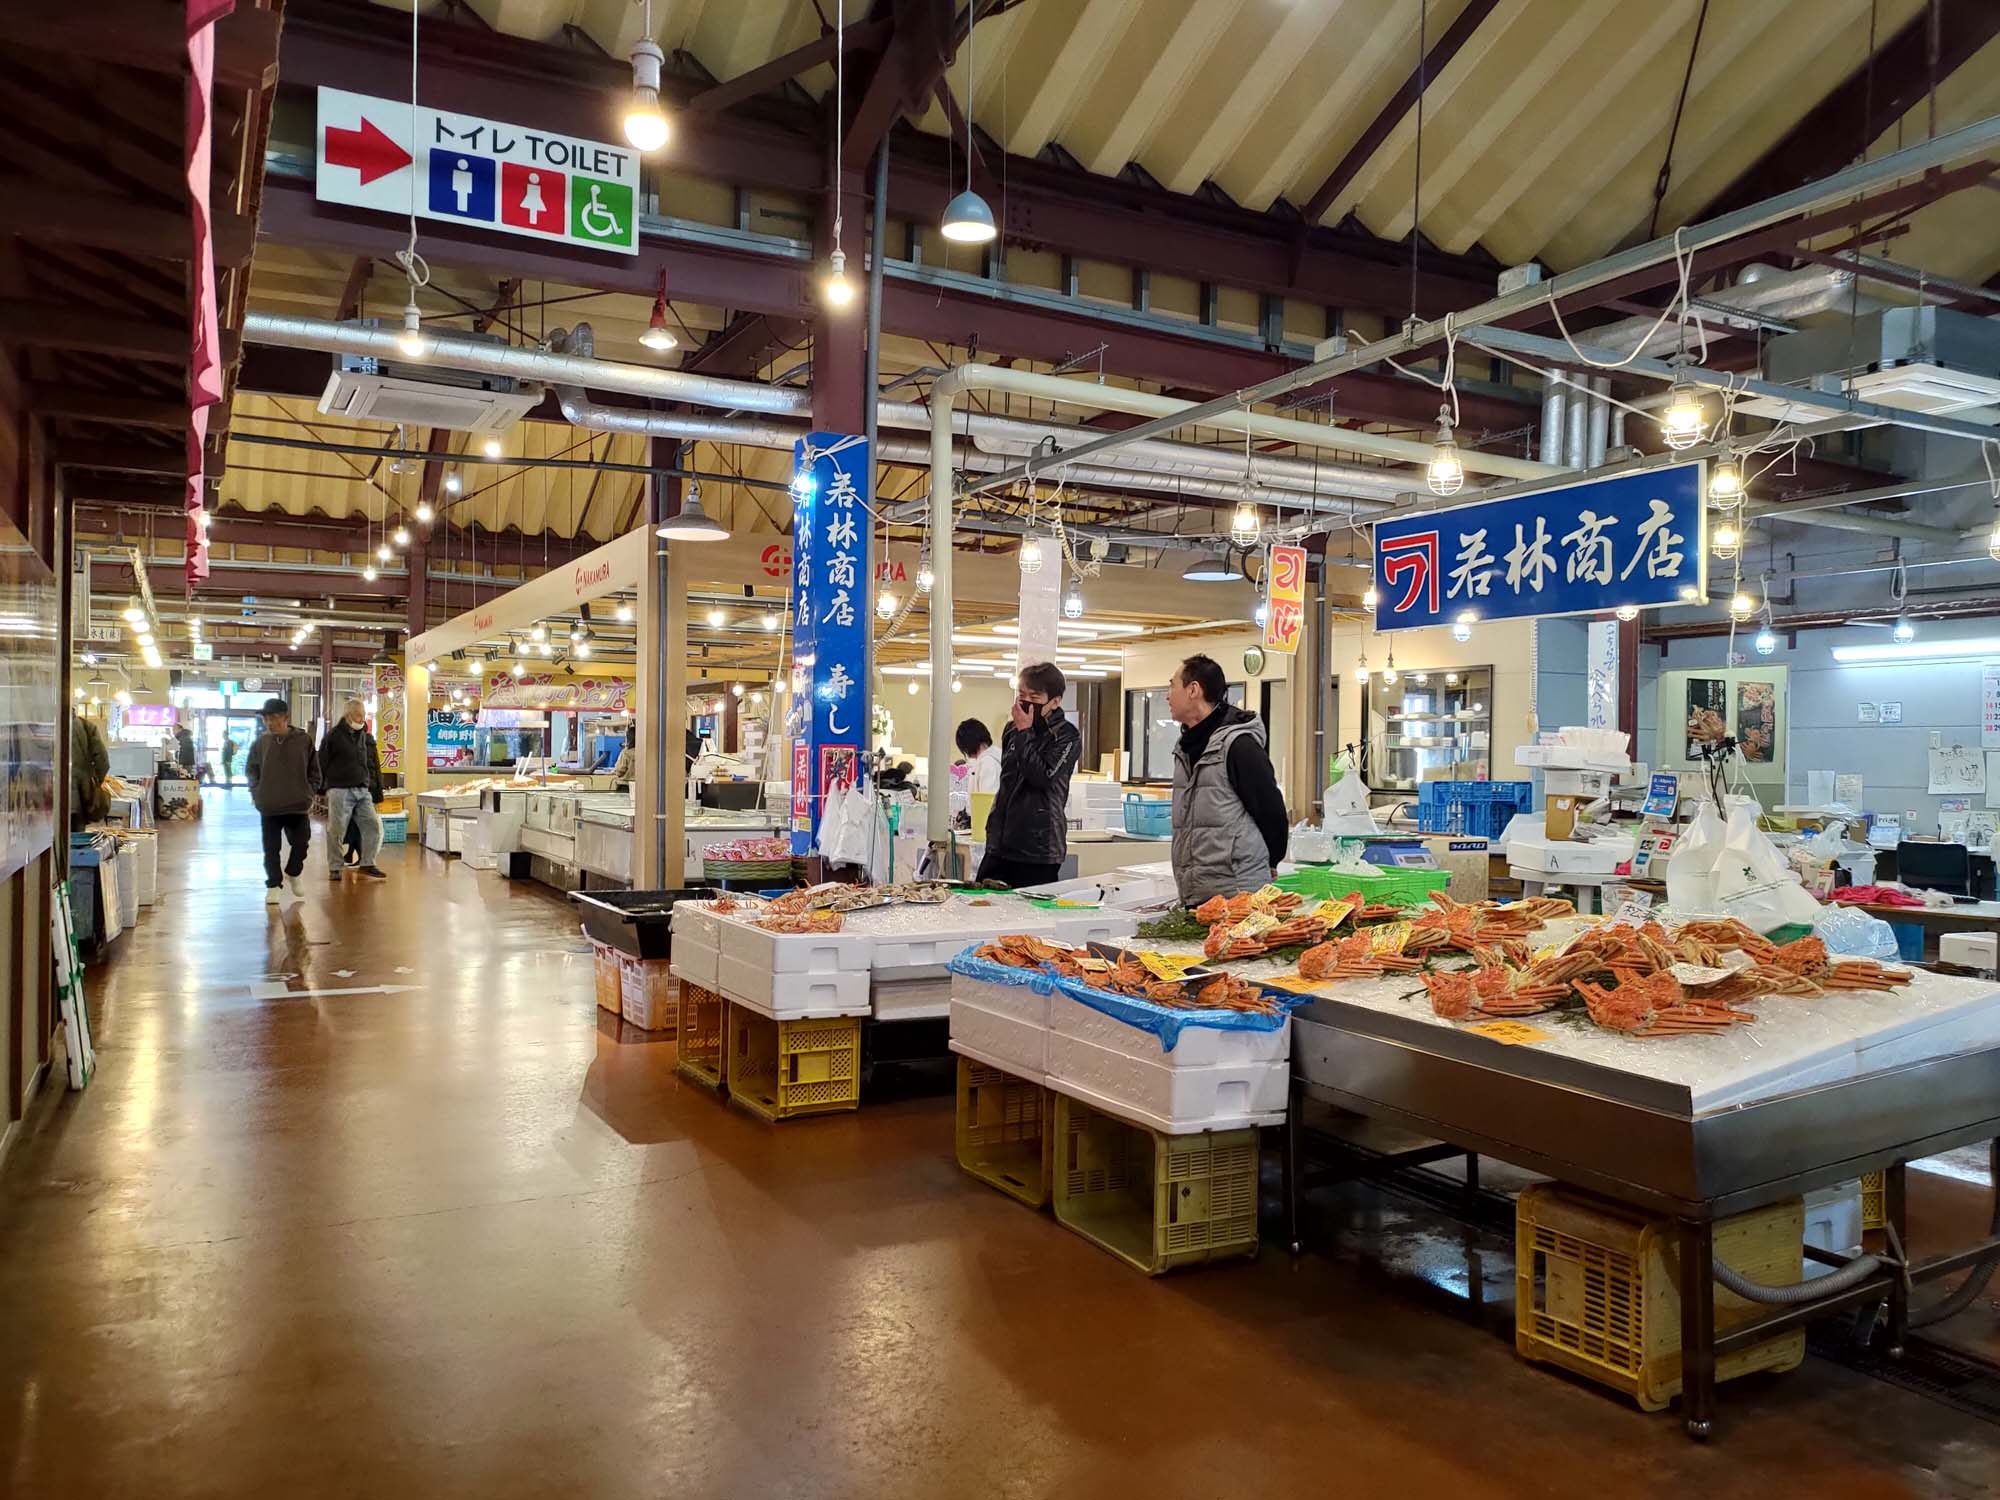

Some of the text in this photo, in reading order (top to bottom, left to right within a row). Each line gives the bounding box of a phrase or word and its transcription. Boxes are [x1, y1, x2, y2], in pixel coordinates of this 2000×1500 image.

[435, 116, 628, 177] トイレ TOILET
[582, 560, 610, 588] NAKAMURA
[823, 472, 858, 627] 若林商店
[1446, 499, 1685, 600] 若林商店
[1550, 855, 1559, 869] A
